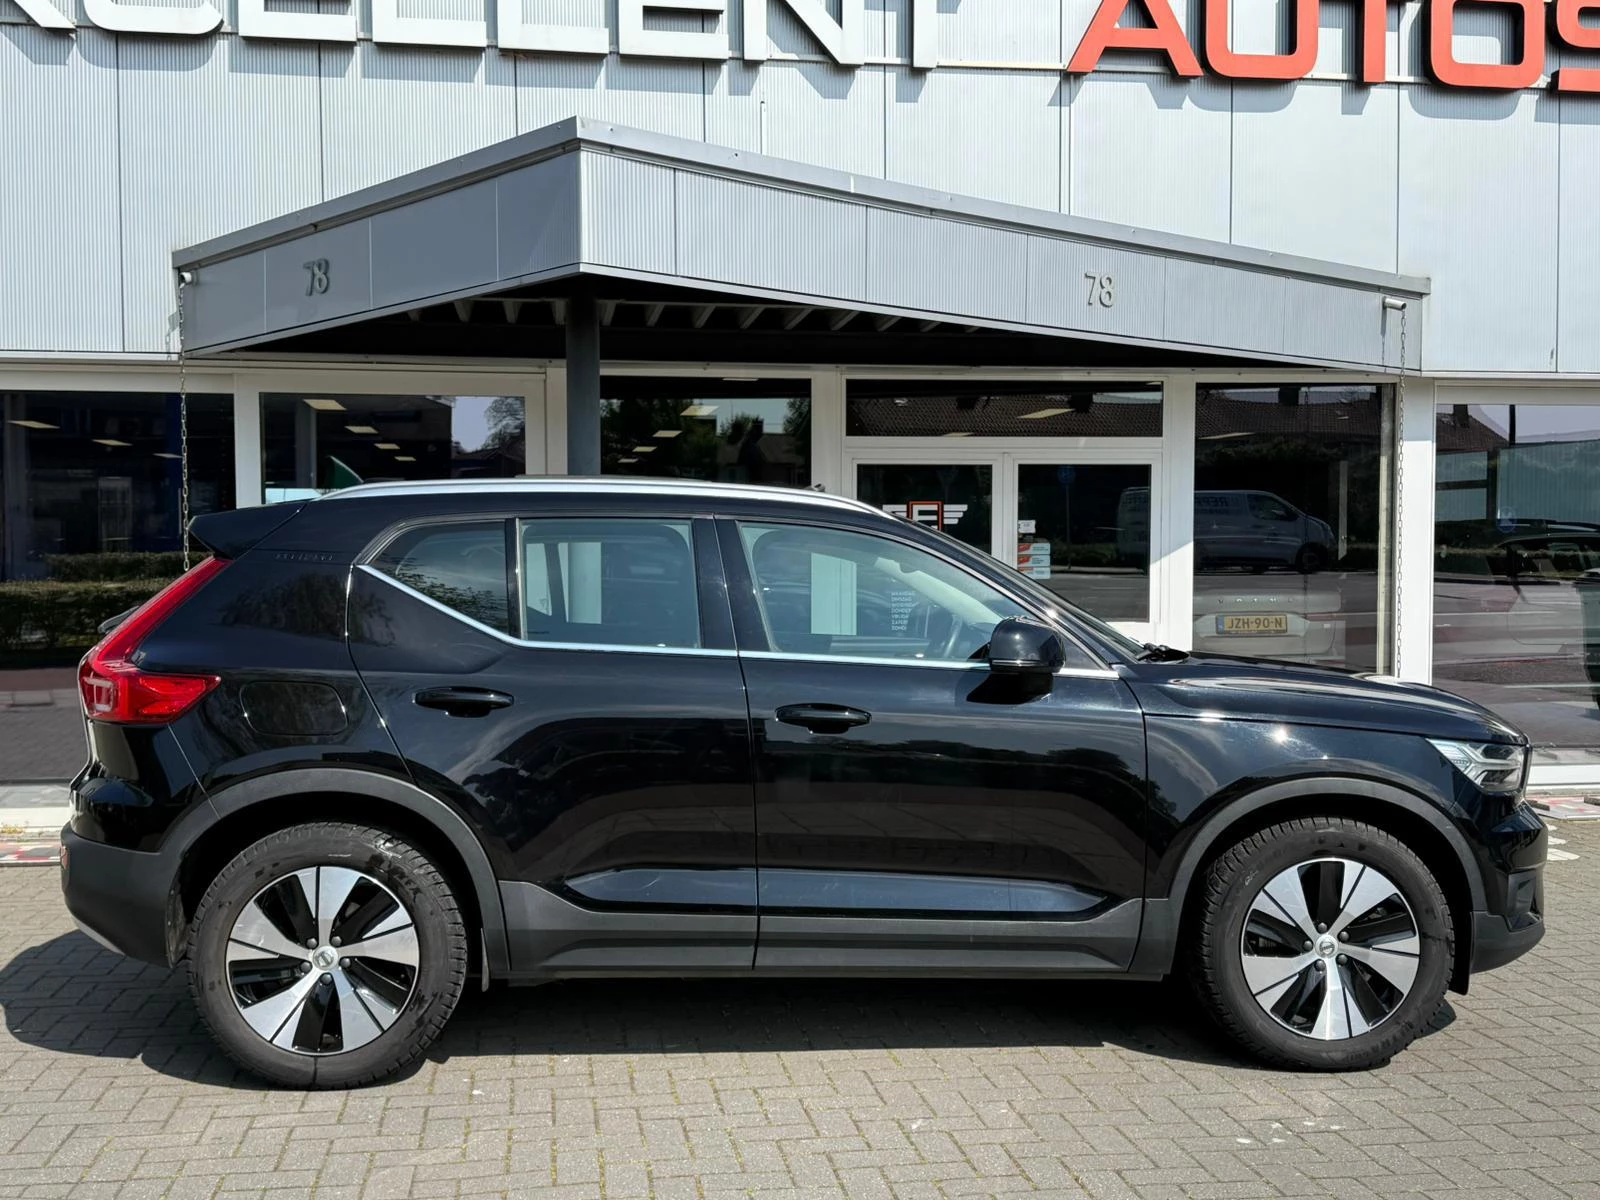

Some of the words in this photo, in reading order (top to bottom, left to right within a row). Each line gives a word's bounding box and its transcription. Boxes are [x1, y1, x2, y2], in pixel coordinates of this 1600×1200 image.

[303, 258, 329, 297] 78
[1084, 271, 1115, 309] 78
[1227, 616, 1283, 629] JZH-90-N
